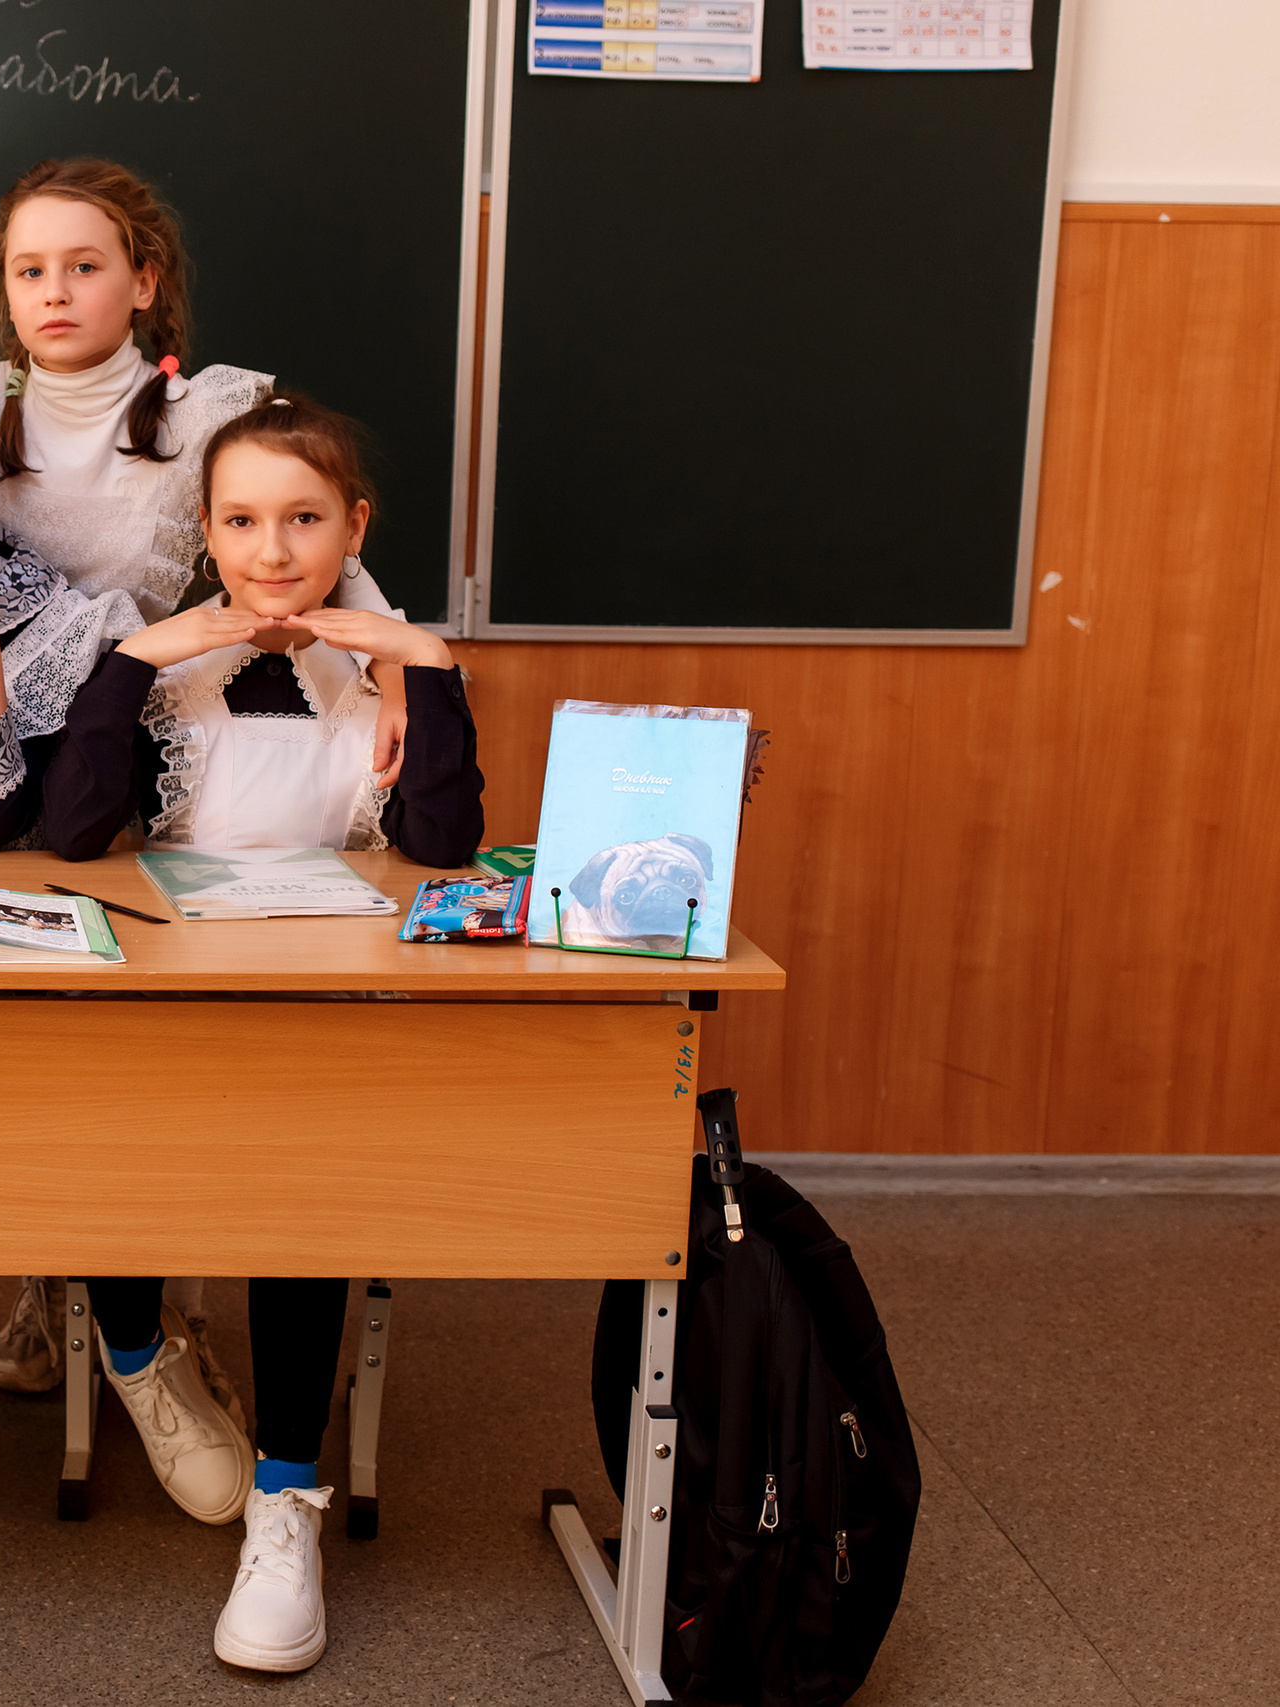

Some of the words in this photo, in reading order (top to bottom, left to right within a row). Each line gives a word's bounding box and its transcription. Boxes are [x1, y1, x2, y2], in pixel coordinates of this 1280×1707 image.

[612, 767, 673, 786] Дневник
[613, 785, 666, 795] школьный
[673, 1045, 695, 1099] 43/2
